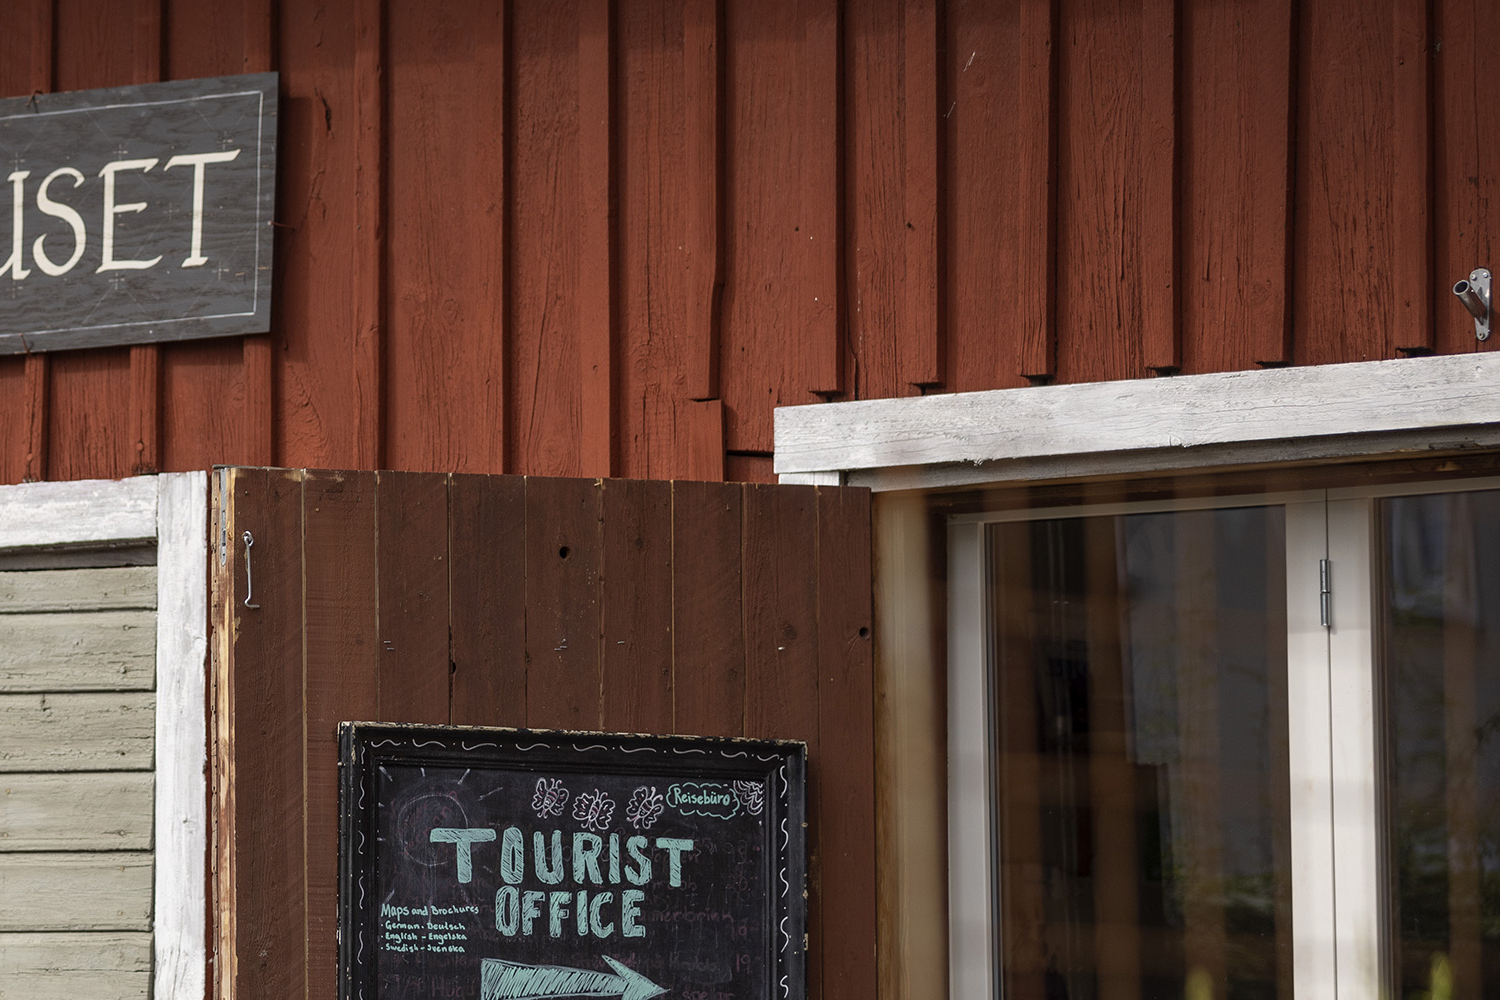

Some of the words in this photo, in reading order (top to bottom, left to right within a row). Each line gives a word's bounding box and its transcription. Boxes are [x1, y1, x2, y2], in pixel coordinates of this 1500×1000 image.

[673, 787, 731, 805] Reisebüro
[430, 826, 694, 887] TOURIST
[381, 903, 409, 921] Maps
[411, 905, 428, 916] and
[430, 905, 479, 915] Brochures
[495, 885, 646, 938] OFFICE
[385, 920, 420, 930] German
[427, 921, 465, 930] Deutsch
[385, 932, 418, 943] English
[428, 932, 467, 944] Engelska
[386, 943, 418, 953] Swedish
[427, 944, 465, 953] Svenska
